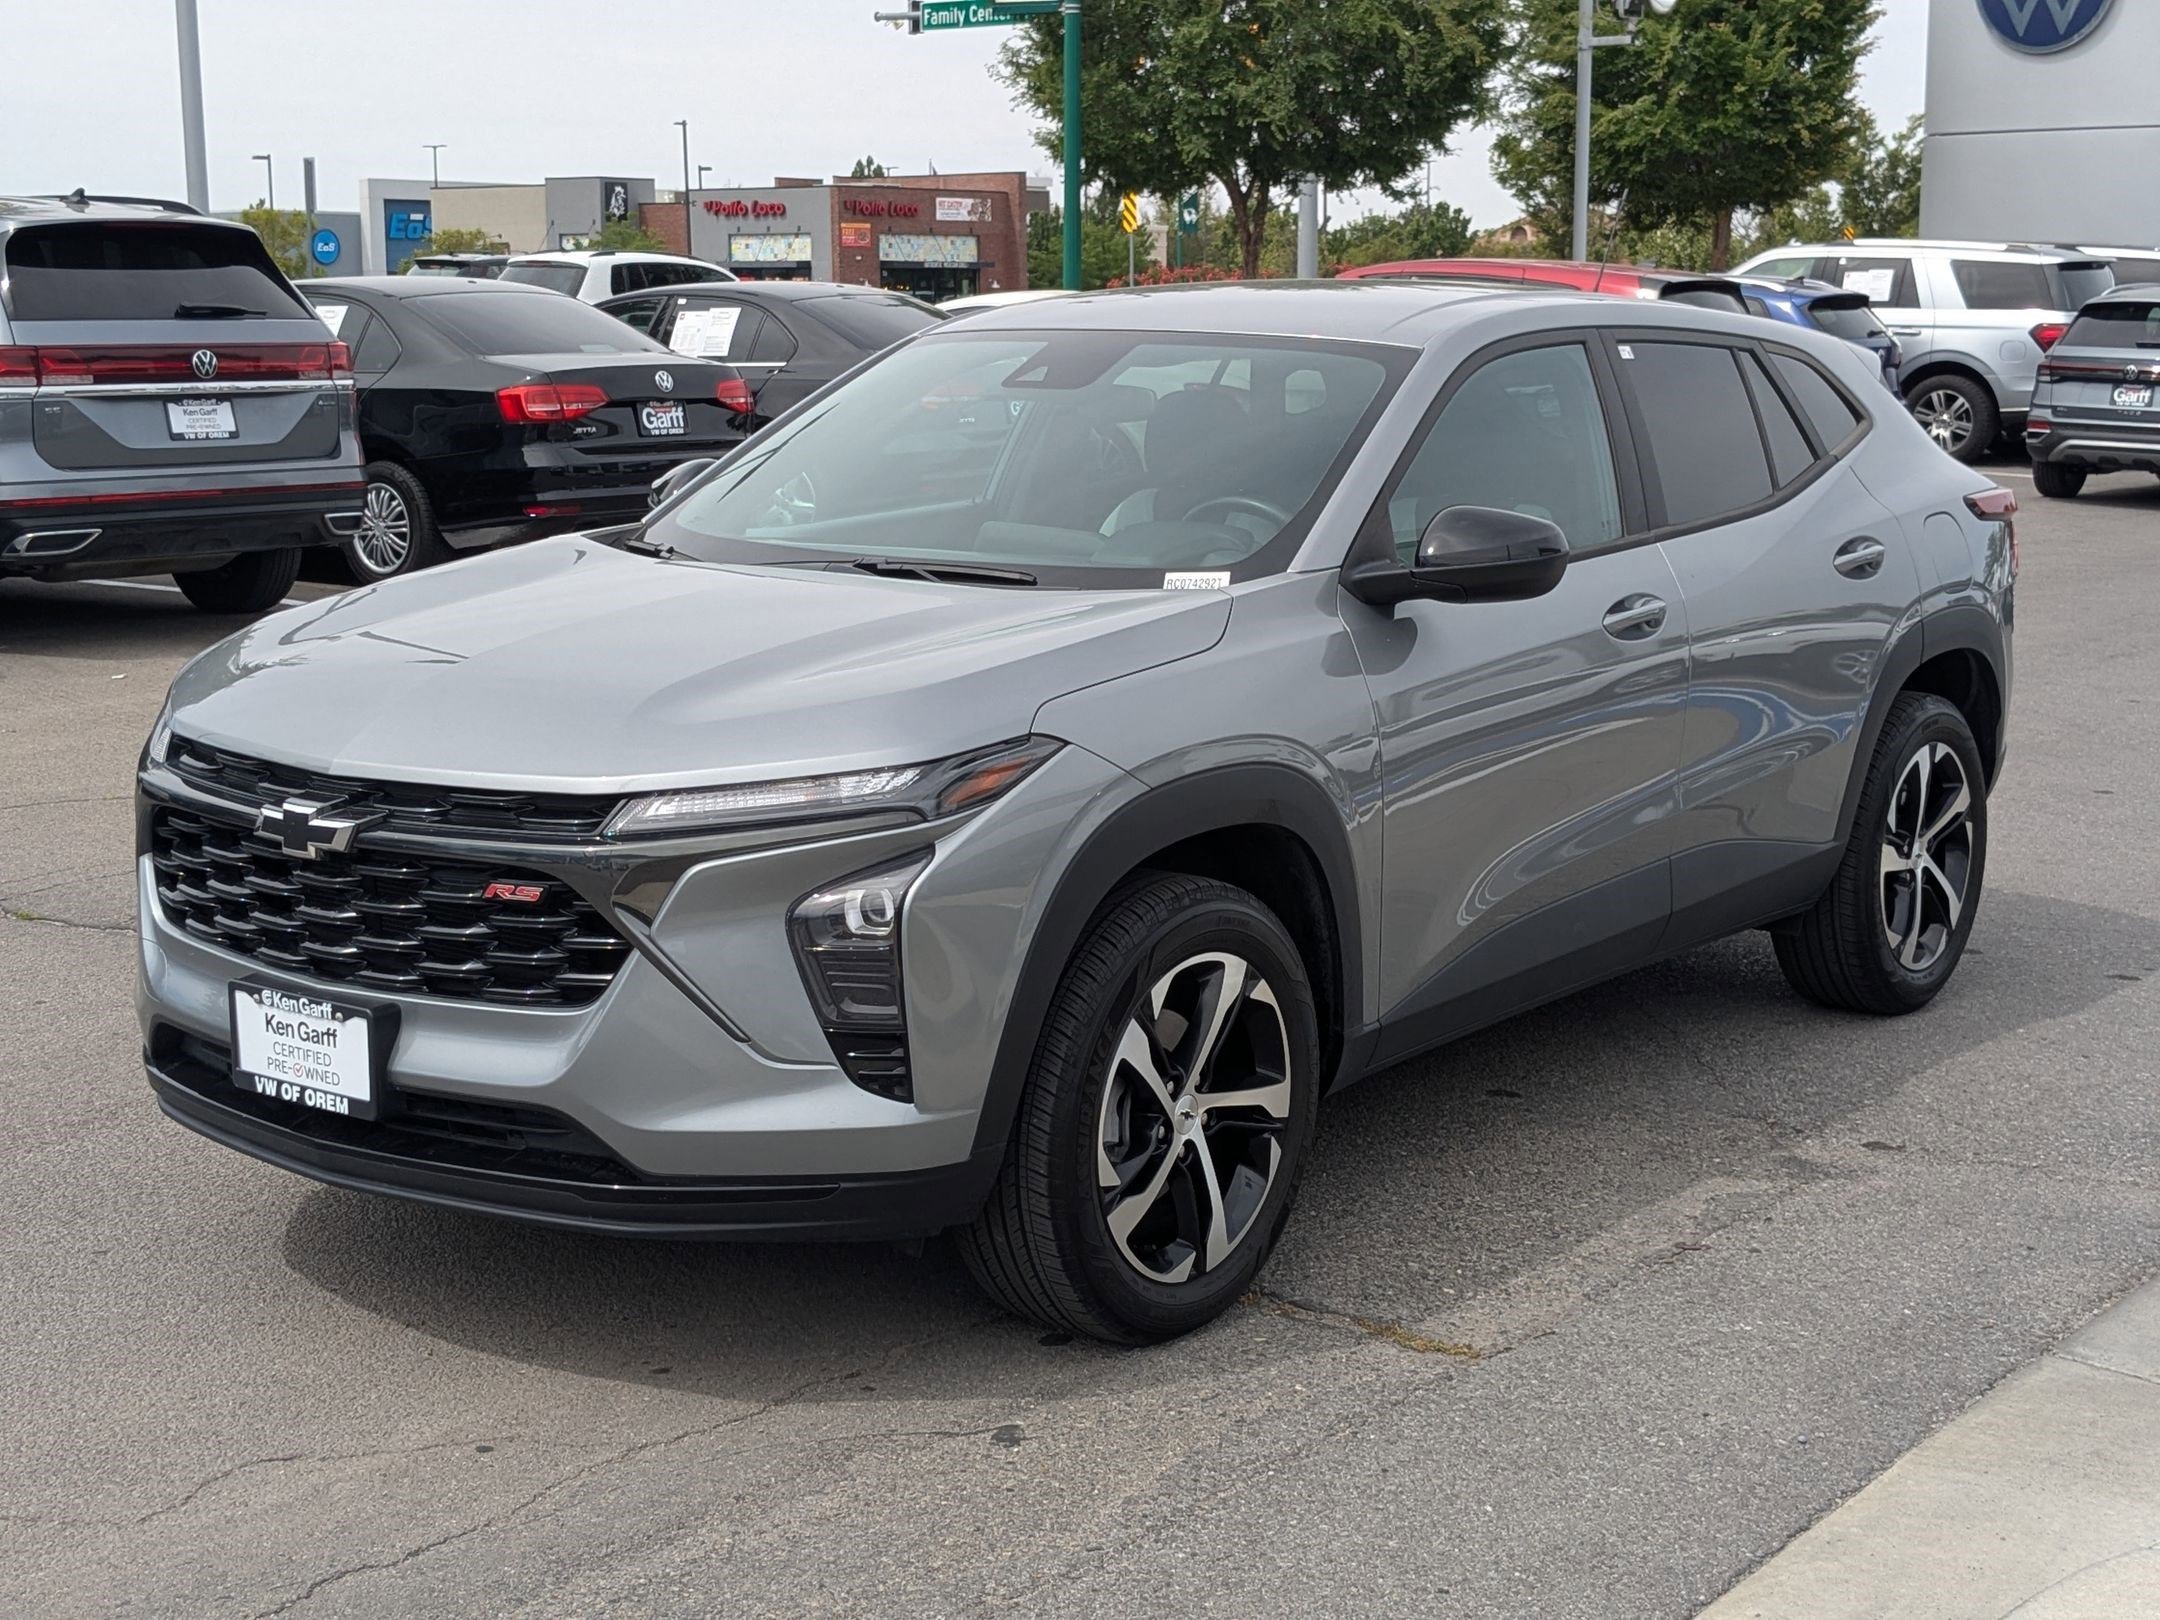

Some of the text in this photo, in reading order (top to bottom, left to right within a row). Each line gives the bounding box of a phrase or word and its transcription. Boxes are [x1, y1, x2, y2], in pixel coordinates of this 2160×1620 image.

[923, 5, 1011, 28] Family Cen
[713, 201, 748, 217] Pollo
[751, 200, 786, 217] Loco
[855, 200, 886, 216] Pollo
[888, 200, 919, 217] Loco
[2113, 387, 2152, 404] Garff
[642, 406, 684, 430] Garff
[484, 883, 544, 902] RS
[265, 1013, 338, 1048] Ken Garff
[272, 1041, 332, 1067] CERTIFIED
[254, 1075, 349, 1115] VW OF OREM
